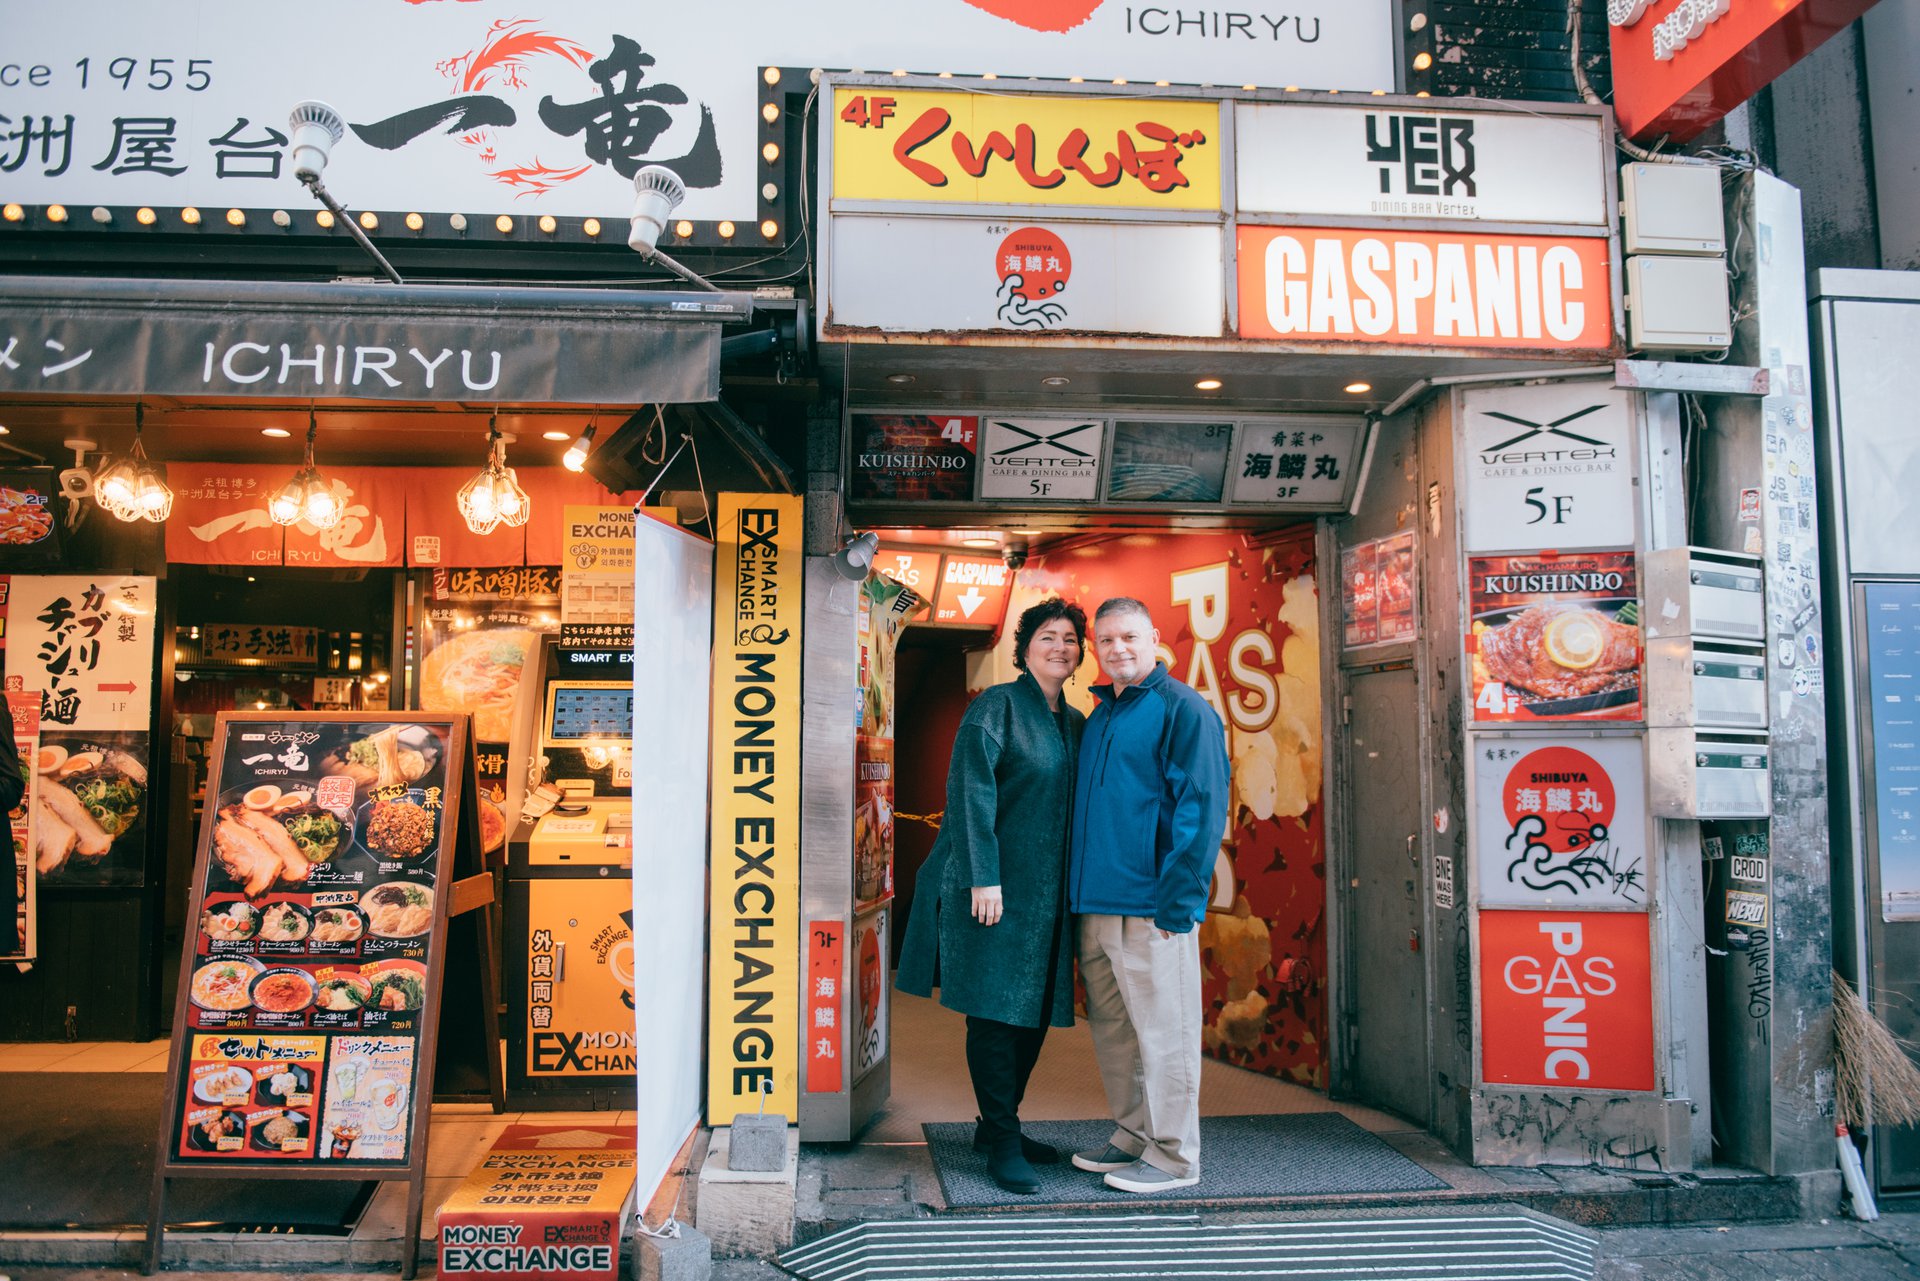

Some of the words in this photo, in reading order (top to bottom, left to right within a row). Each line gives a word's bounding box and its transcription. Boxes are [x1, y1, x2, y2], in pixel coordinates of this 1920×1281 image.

[1126, 8, 1320, 43] ICHIRYU
[76, 57, 213, 91] 1955
[348, 34, 723, 189] 一竜
[841, 95, 896, 128] 4F
[893, 107, 1206, 193] くいしんぼ
[1436, 201, 1475, 216] Vertex
[1015, 244, 1053, 252] SHIBUYA
[1004, 254, 1063, 273] 海鱗丸
[1264, 235, 1585, 342] GASPANIC
[203, 341, 501, 391] ICHIRYU
[940, 419, 974, 444] 4F
[1205, 425, 1228, 438] 3F
[858, 454, 966, 470] KUISHINBO
[990, 457, 1096, 468] VERTEX
[1480, 448, 1616, 465] VERTEX
[992, 468, 1017, 476] CAFE
[1031, 469, 1068, 477] DINING
[1242, 453, 1341, 481] 海鱗丸
[1484, 468, 1516, 478] CAFE
[1521, 467, 1529, 476] &
[1534, 465, 1582, 474] DINING
[1587, 463, 1613, 472] BAR
[203, 478, 257, 488] 元祖博多
[1030, 479, 1052, 496] 5F
[1276, 487, 1299, 498] 3F
[26, 494, 48, 505] 2F
[1525, 487, 1574, 525] 5F
[945, 561, 1008, 586] GASPANIC
[1484, 572, 1623, 594] KUISHINBO
[938, 609, 957, 618] B1F
[78, 583, 112, 671] カブリ
[216, 627, 293, 656] お手洗
[37, 596, 82, 725] チャーシュー麺
[570, 653, 612, 663] SMART
[111, 702, 127, 712] 1F
[1475, 681, 1521, 714] 4F
[267, 730, 320, 744] ラーメン
[733, 653, 776, 805] MONEY
[241, 741, 310, 772] 一竜
[254, 768, 289, 776] ICHIRYU
[861, 762, 891, 781] KUISHINBO
[1531, 773, 1588, 783] SHIBUYA
[368, 781, 409, 804] オススメ
[1515, 788, 1603, 813] 海鱗丸
[308, 871, 364, 882] チャーシュー麺
[1436, 857, 1452, 880] BNE
[1733, 858, 1764, 879] CROD
[1436, 880, 1452, 893] WAS
[1436, 892, 1452, 907] HERE
[363, 939, 421, 949] とんこつラーメン
[590, 925, 613, 951] SMART
[596, 929, 629, 965] EXCHANGE
[402, 948, 425, 957] 730円
[732, 817, 775, 1096] EXCHANGE
[531, 929, 553, 1029] 外貨両替
[363, 1011, 388, 1021] 油そば
[391, 1020, 412, 1029] 720円
[815, 976, 836, 1060] 海鱗丸
[218, 1036, 317, 1060] セットメニュー
[337, 1038, 411, 1056] ドリンクメニュー
[482, 1160, 635, 1169] EXCHANGE
[479, 1194, 592, 1204] 외화환전
[444, 1226, 522, 1244] MONEY
[444, 1248, 610, 1272] EXCHANGE
